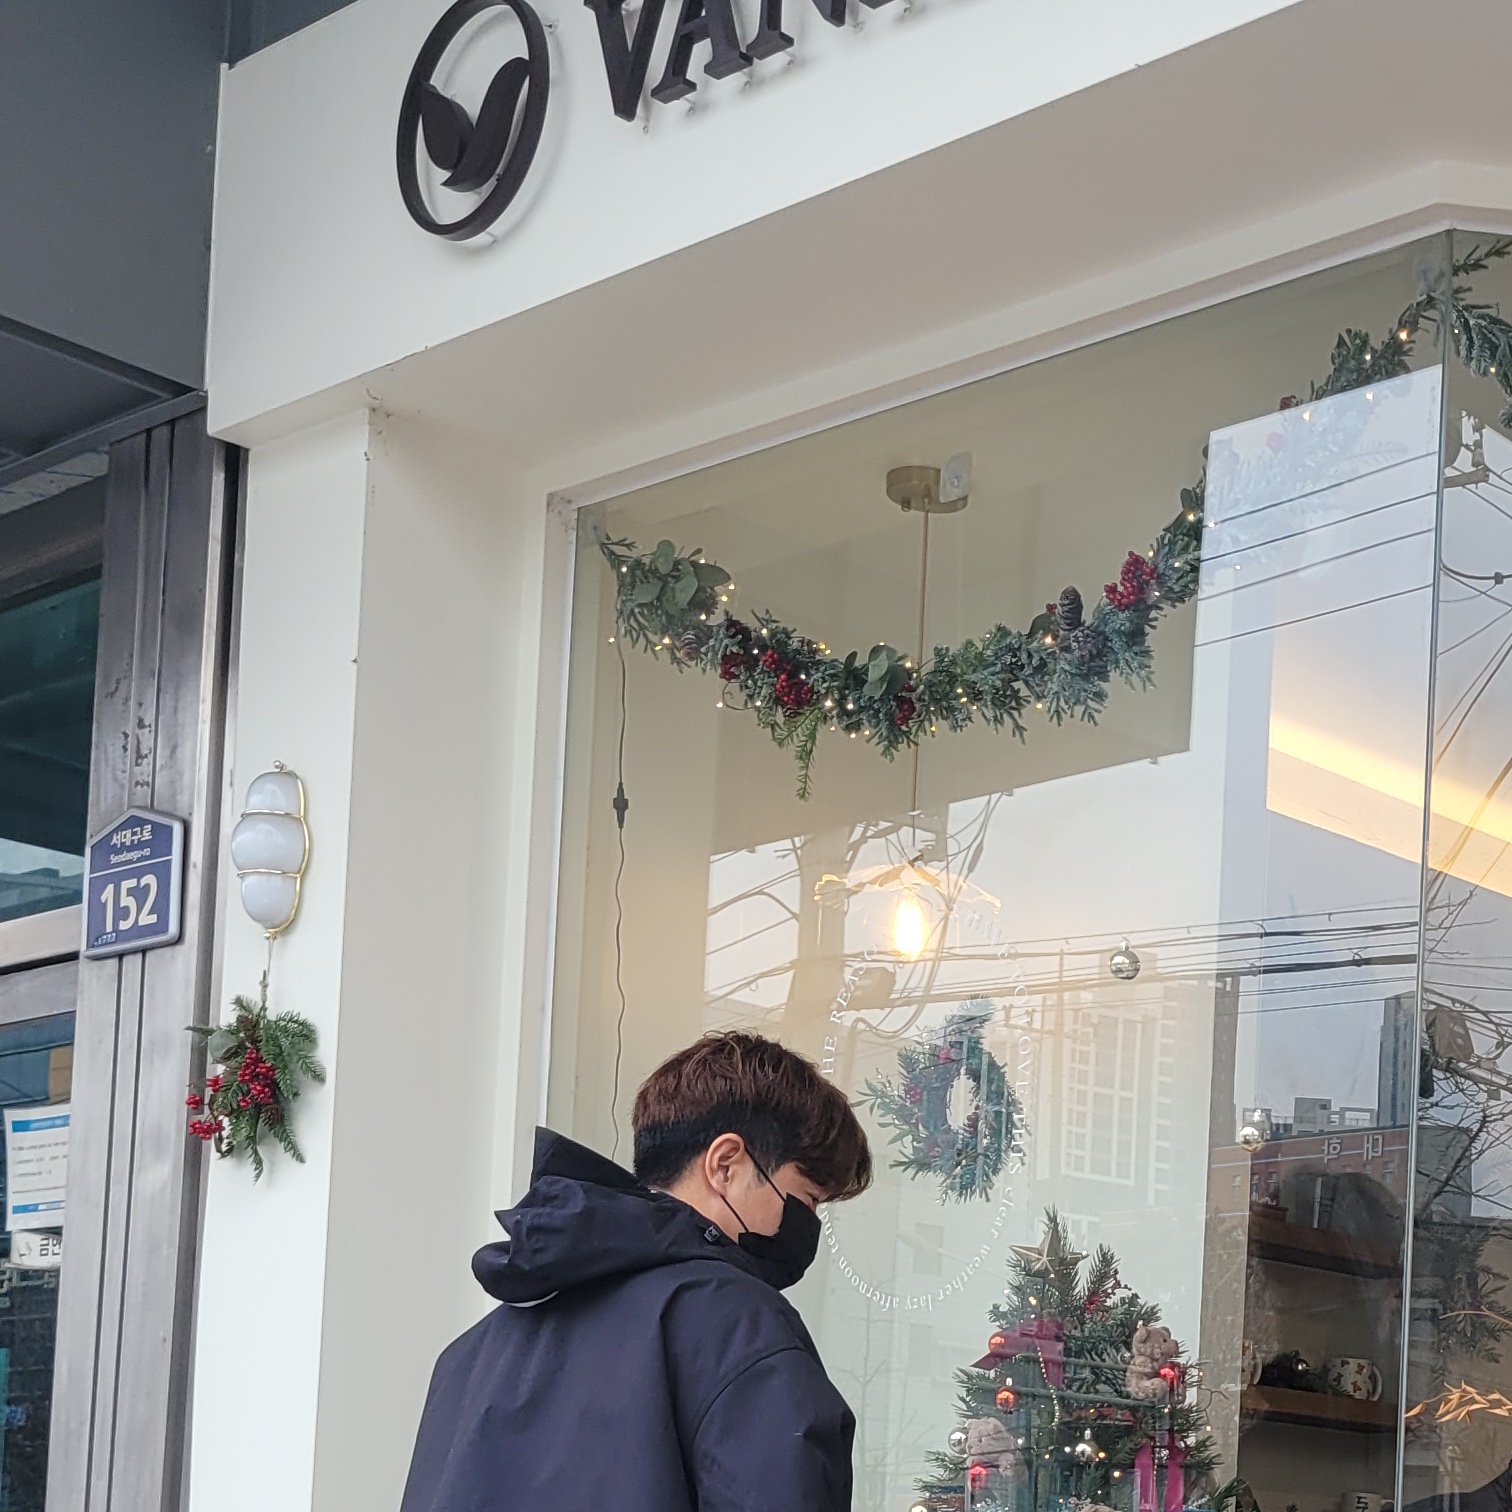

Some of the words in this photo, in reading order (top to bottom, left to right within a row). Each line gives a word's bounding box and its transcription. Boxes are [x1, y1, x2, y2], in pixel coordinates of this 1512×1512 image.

[110, 824, 153, 848] 서대구로
[100, 874, 158, 933] 152
[838, 1255, 900, 1312] afternoon
